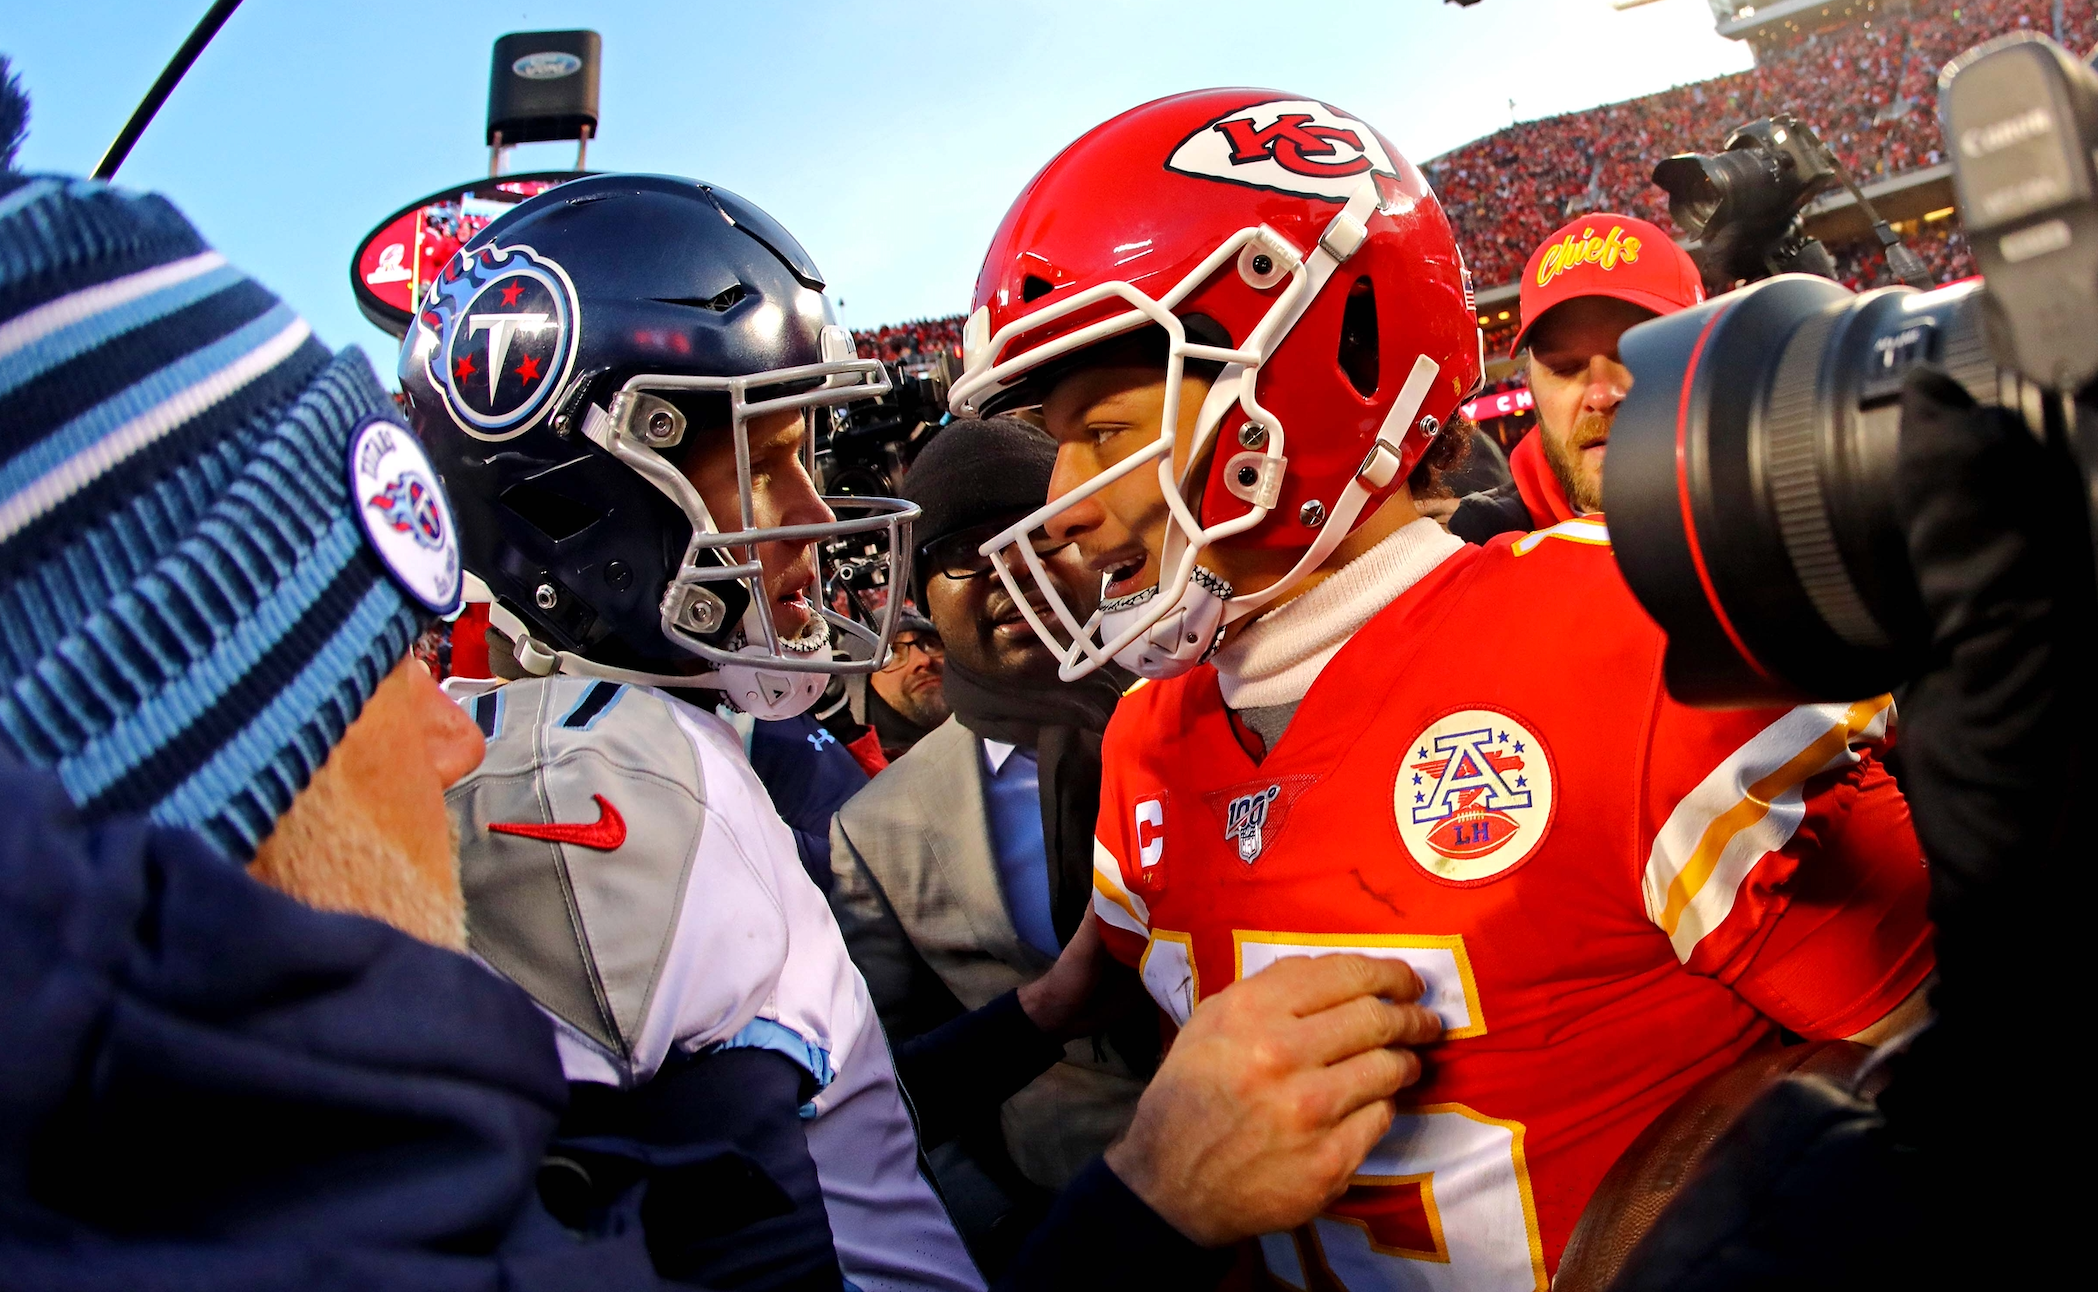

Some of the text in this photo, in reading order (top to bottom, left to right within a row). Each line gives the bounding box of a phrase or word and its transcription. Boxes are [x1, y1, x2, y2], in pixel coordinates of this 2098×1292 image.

[1212, 114, 1374, 178] KC
[1961, 108, 2051, 158] Canon
[1536, 226, 1641, 287] Chiefs
[1412, 728, 1533, 825] A
[1135, 799, 1163, 869] C
[1454, 821, 1490, 846] LH
